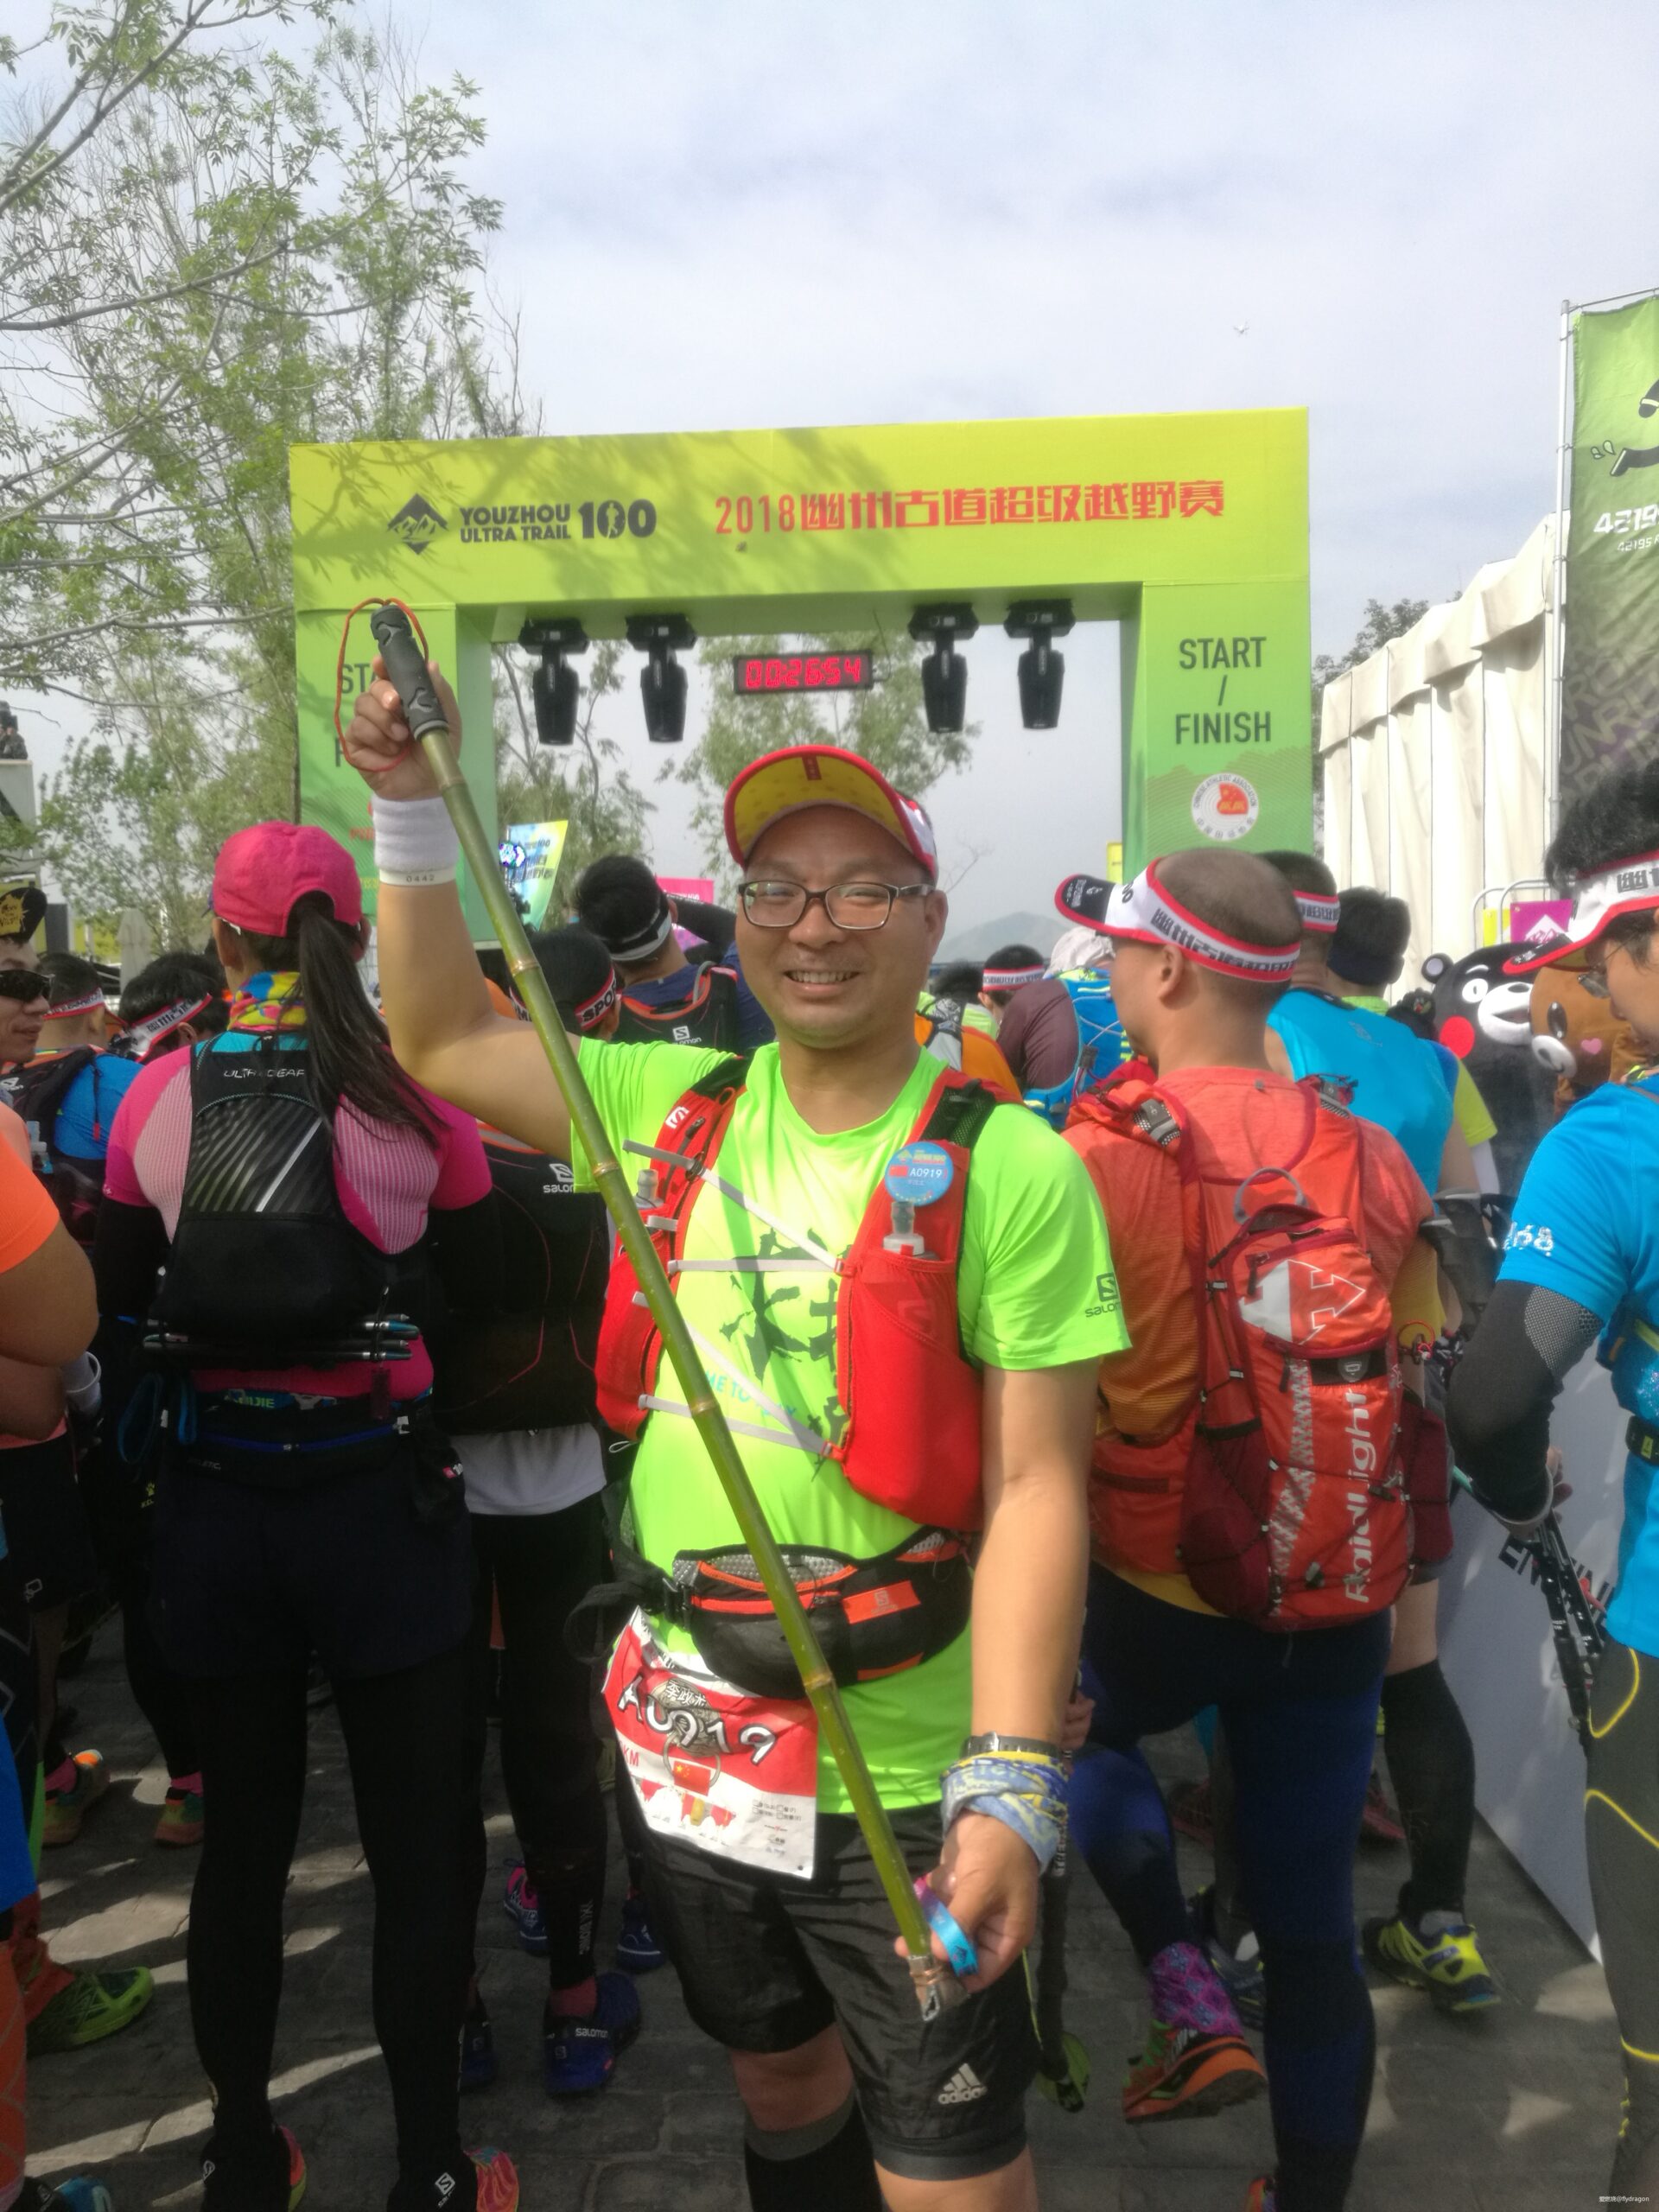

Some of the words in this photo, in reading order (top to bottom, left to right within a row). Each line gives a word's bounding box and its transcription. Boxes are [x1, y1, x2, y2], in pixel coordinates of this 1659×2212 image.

[460, 503, 571, 525] YOUZHOU
[578, 499, 657, 539] 100
[1593, 504, 1659, 533] 4219
[460, 526, 517, 543] ULTRA
[520, 524, 571, 541] TRAIL
[1179, 636, 1267, 670] START
[1175, 711, 1271, 744] FINISH
[910, 1167, 942, 1178] A0919
